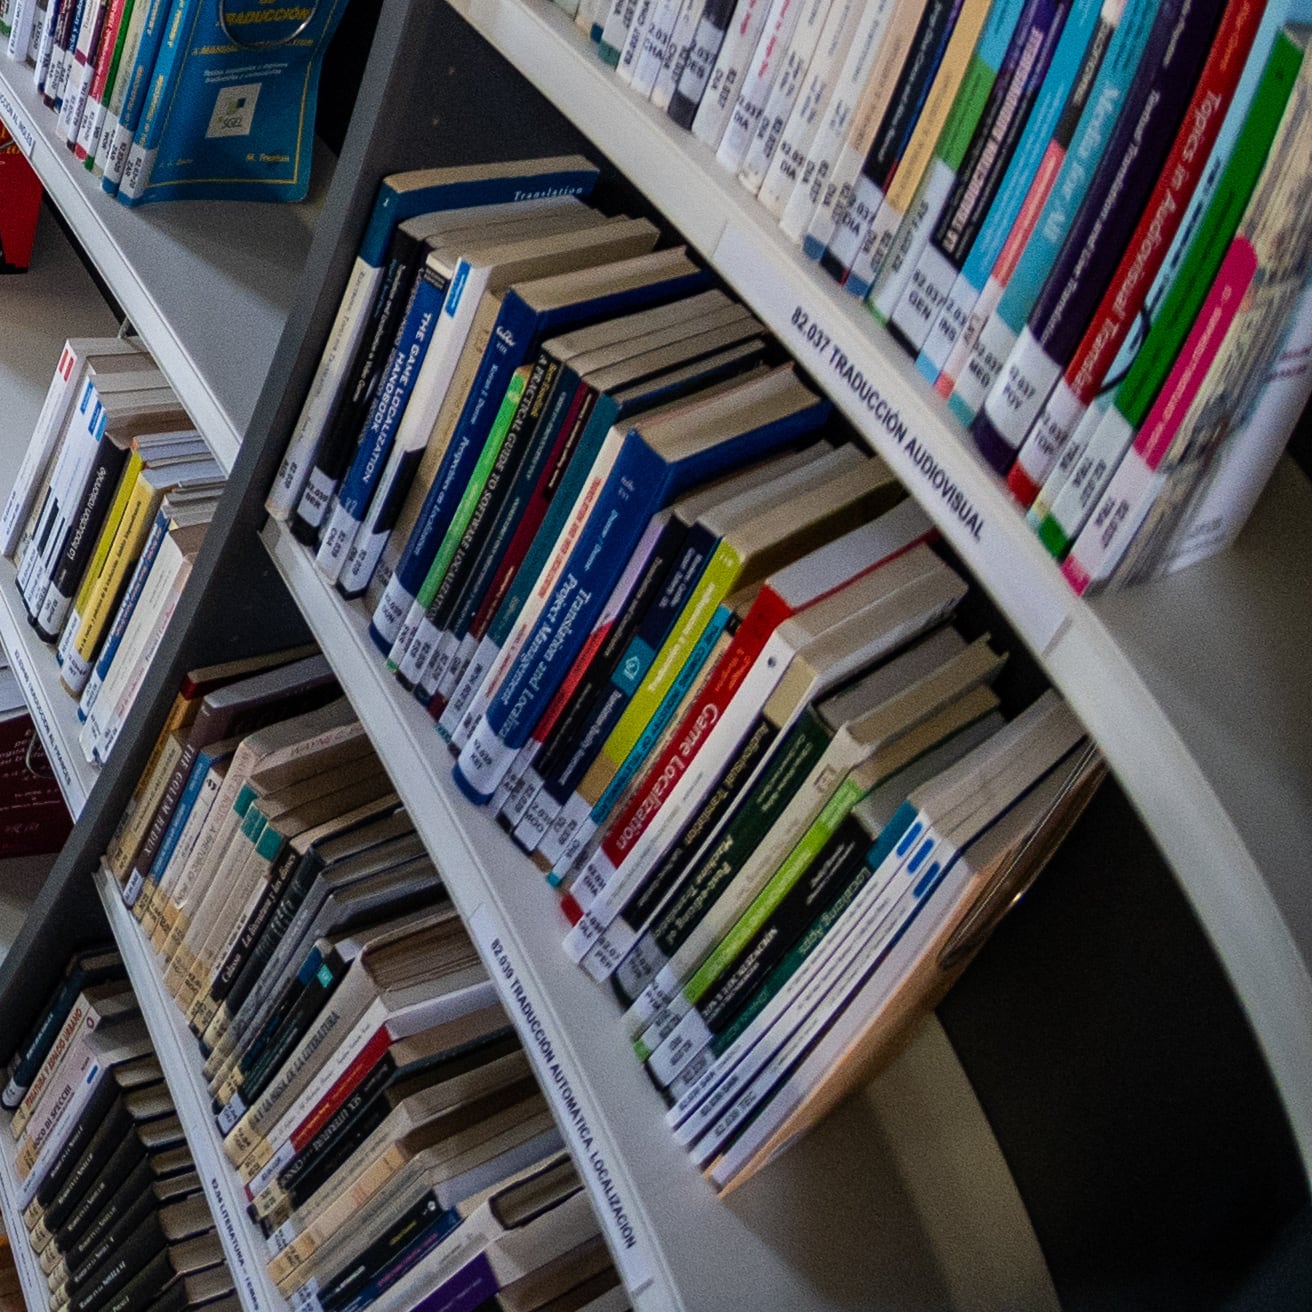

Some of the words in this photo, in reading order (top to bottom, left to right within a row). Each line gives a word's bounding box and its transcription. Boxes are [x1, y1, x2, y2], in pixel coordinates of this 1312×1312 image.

[1076, 85, 1121, 161] Media
[1175, 87, 1223, 164] Topics
[1166, 162, 1190, 191] in
[1109, 187, 1180, 320] Audiovisual
[413, 311, 433, 341] THE
[397, 343, 422, 386] GAME
[368, 351, 408, 432] HANDBOOK
[510, 363, 546, 431] PRACTICAL
[358, 386, 406, 483] LOCALIZATION
[786, 304, 833, 355] 82.037
[823, 343, 912, 446] TRADUCCIÓN
[900, 435, 992, 543] AUDIOVISUAL
[439, 435, 472, 492] Perspectives
[493, 430, 518, 471] GUIDE
[85, 465, 109, 509] raisonnée
[71, 506, 93, 542] traduction
[411, 503, 441, 557] Localization
[462, 488, 493, 545] SOFTWARE
[66, 541, 81, 561] La
[539, 586, 593, 665] Translation
[544, 575, 580, 625] Project
[496, 622, 552, 706] Management
[526, 661, 551, 691] and
[677, 700, 721, 757] Game
[720, 721, 772, 788] Audiovisual
[176, 742, 195, 770] THE
[159, 771, 184, 814] GOLEM
[612, 753, 685, 853] Localization
[681, 787, 727, 847] Translation
[141, 813, 166, 856] REDUX
[269, 877, 285, 894] los
[275, 851, 299, 881] dioses
[244, 896, 274, 936] literatura
[818, 864, 873, 928] Localizing
[238, 933, 252, 948] La
[795, 921, 827, 957] Apps
[60, 1007, 86, 1040] URBANO
[48, 1083, 73, 1120] SPECCHI
[504, 977, 560, 1064] TRADUCCIÓN
[582, 1149, 642, 1250] LOCALIZACIÓN
[213, 1202, 252, 1267] LITERATURA
